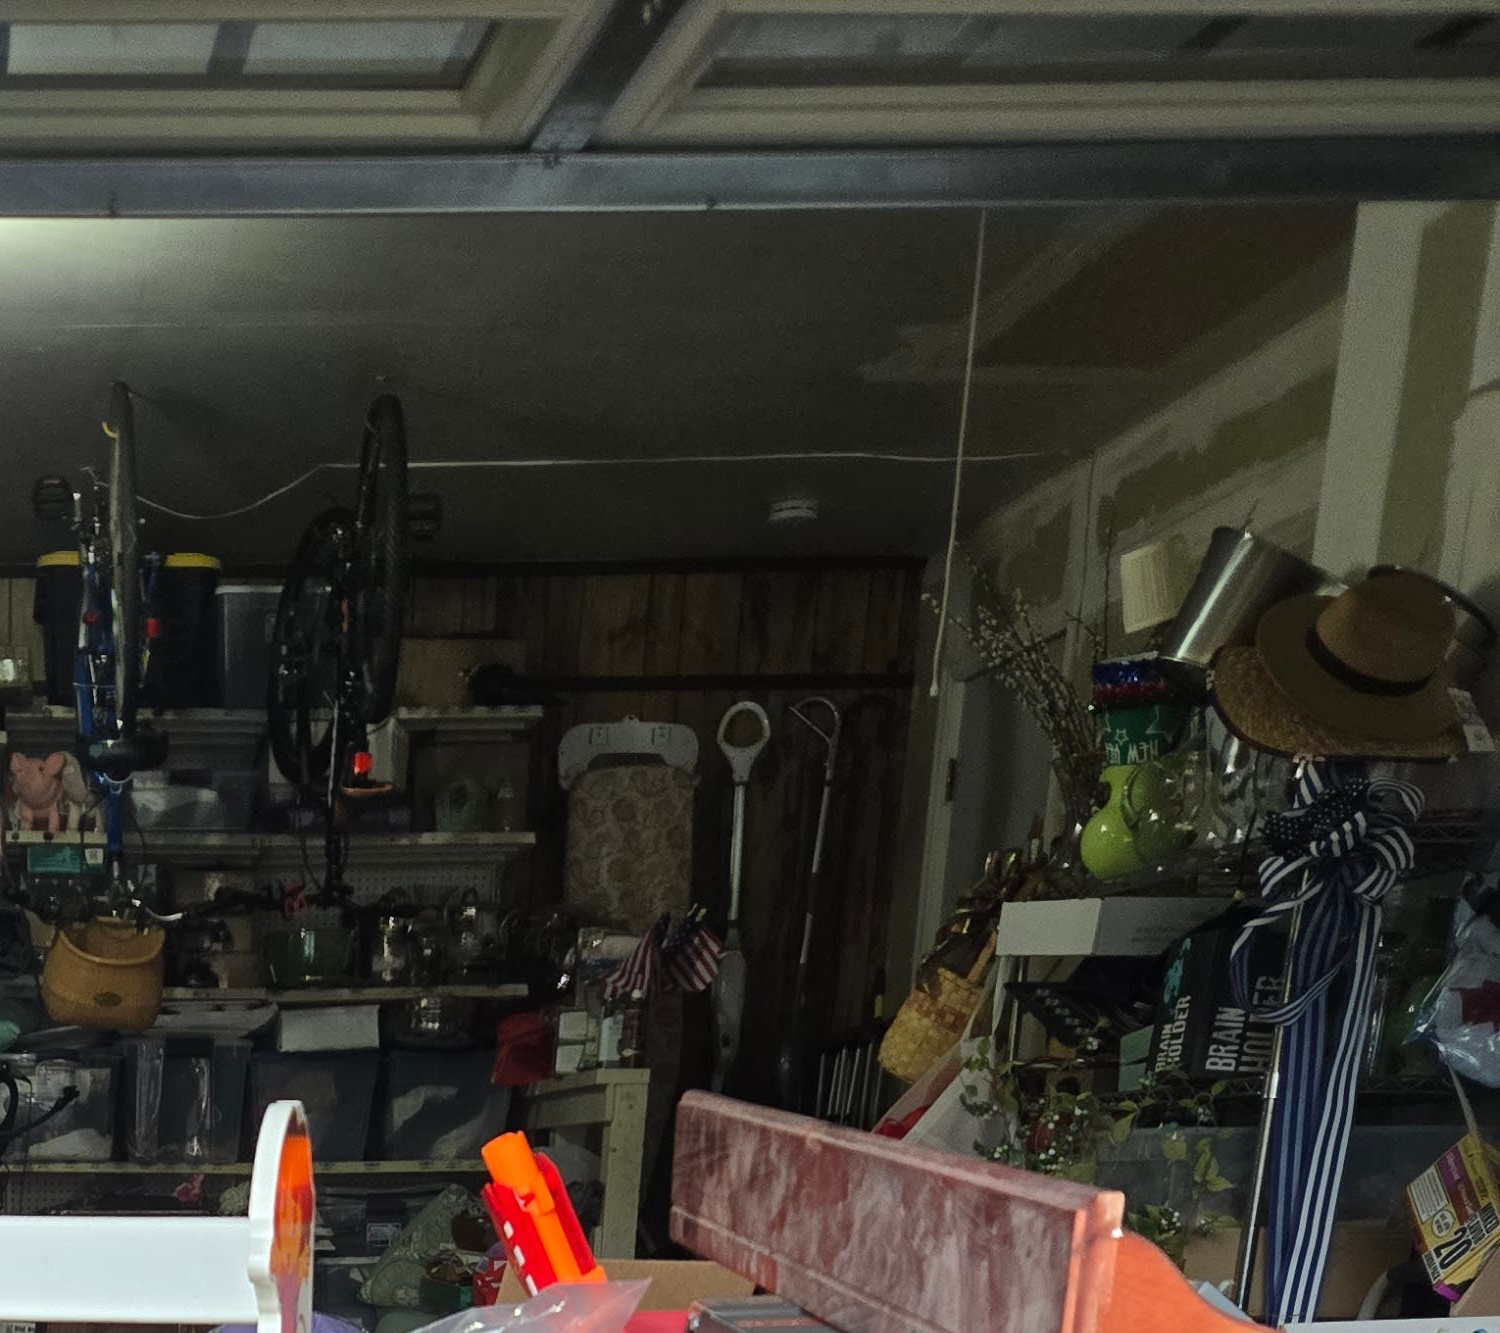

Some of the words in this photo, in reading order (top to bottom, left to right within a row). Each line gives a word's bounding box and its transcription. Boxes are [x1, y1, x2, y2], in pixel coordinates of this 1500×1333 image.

[1155, 1022, 1174, 1073] BRAIN
[1205, 1006, 1247, 1072] BRAIN
[1433, 1226, 1472, 1270] 20
